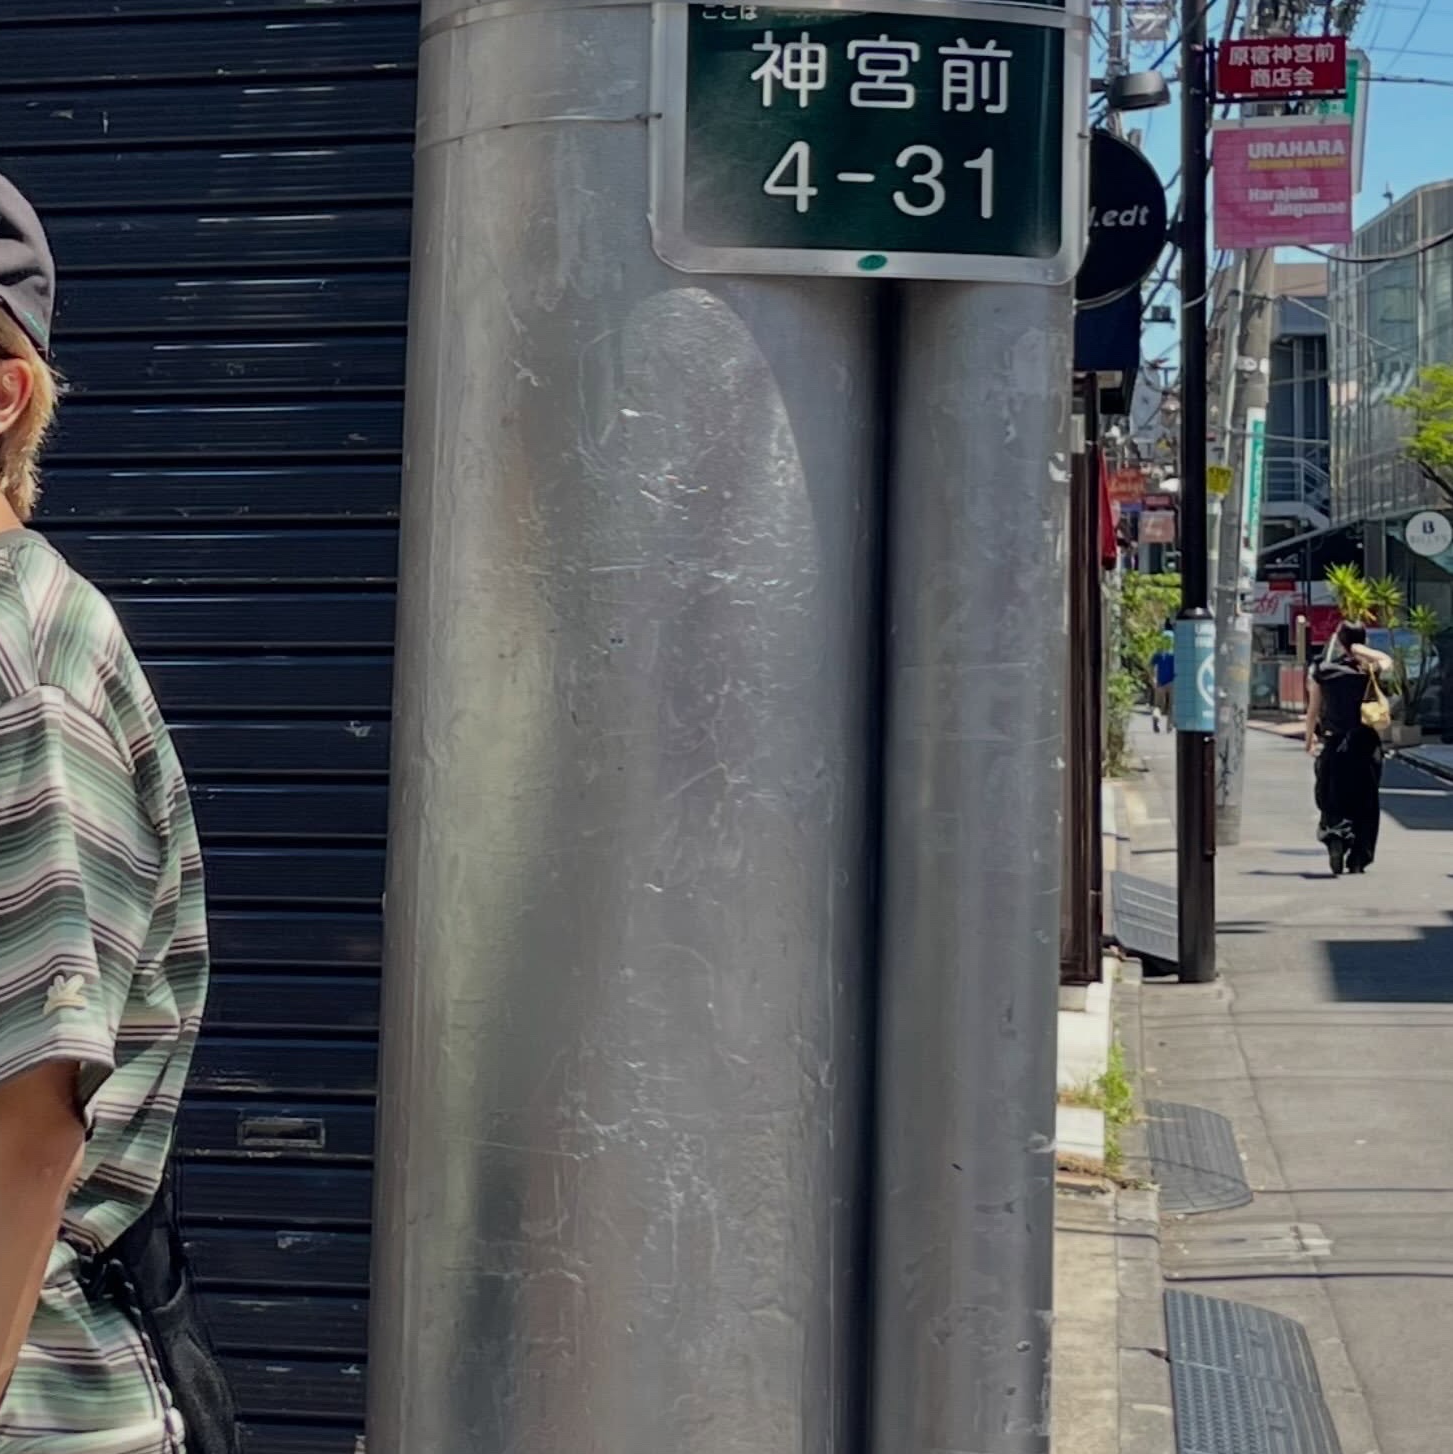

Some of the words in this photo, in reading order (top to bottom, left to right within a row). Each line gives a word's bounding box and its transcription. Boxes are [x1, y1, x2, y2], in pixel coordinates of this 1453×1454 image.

[1228, 42, 1335, 66] 原宿神宮前
[750, 30, 1013, 114] 神宮前
[1250, 67, 1314, 88] 商店会
[1248, 139, 1346, 159] URAHARA
[763, 141, 993, 219] 4-31
